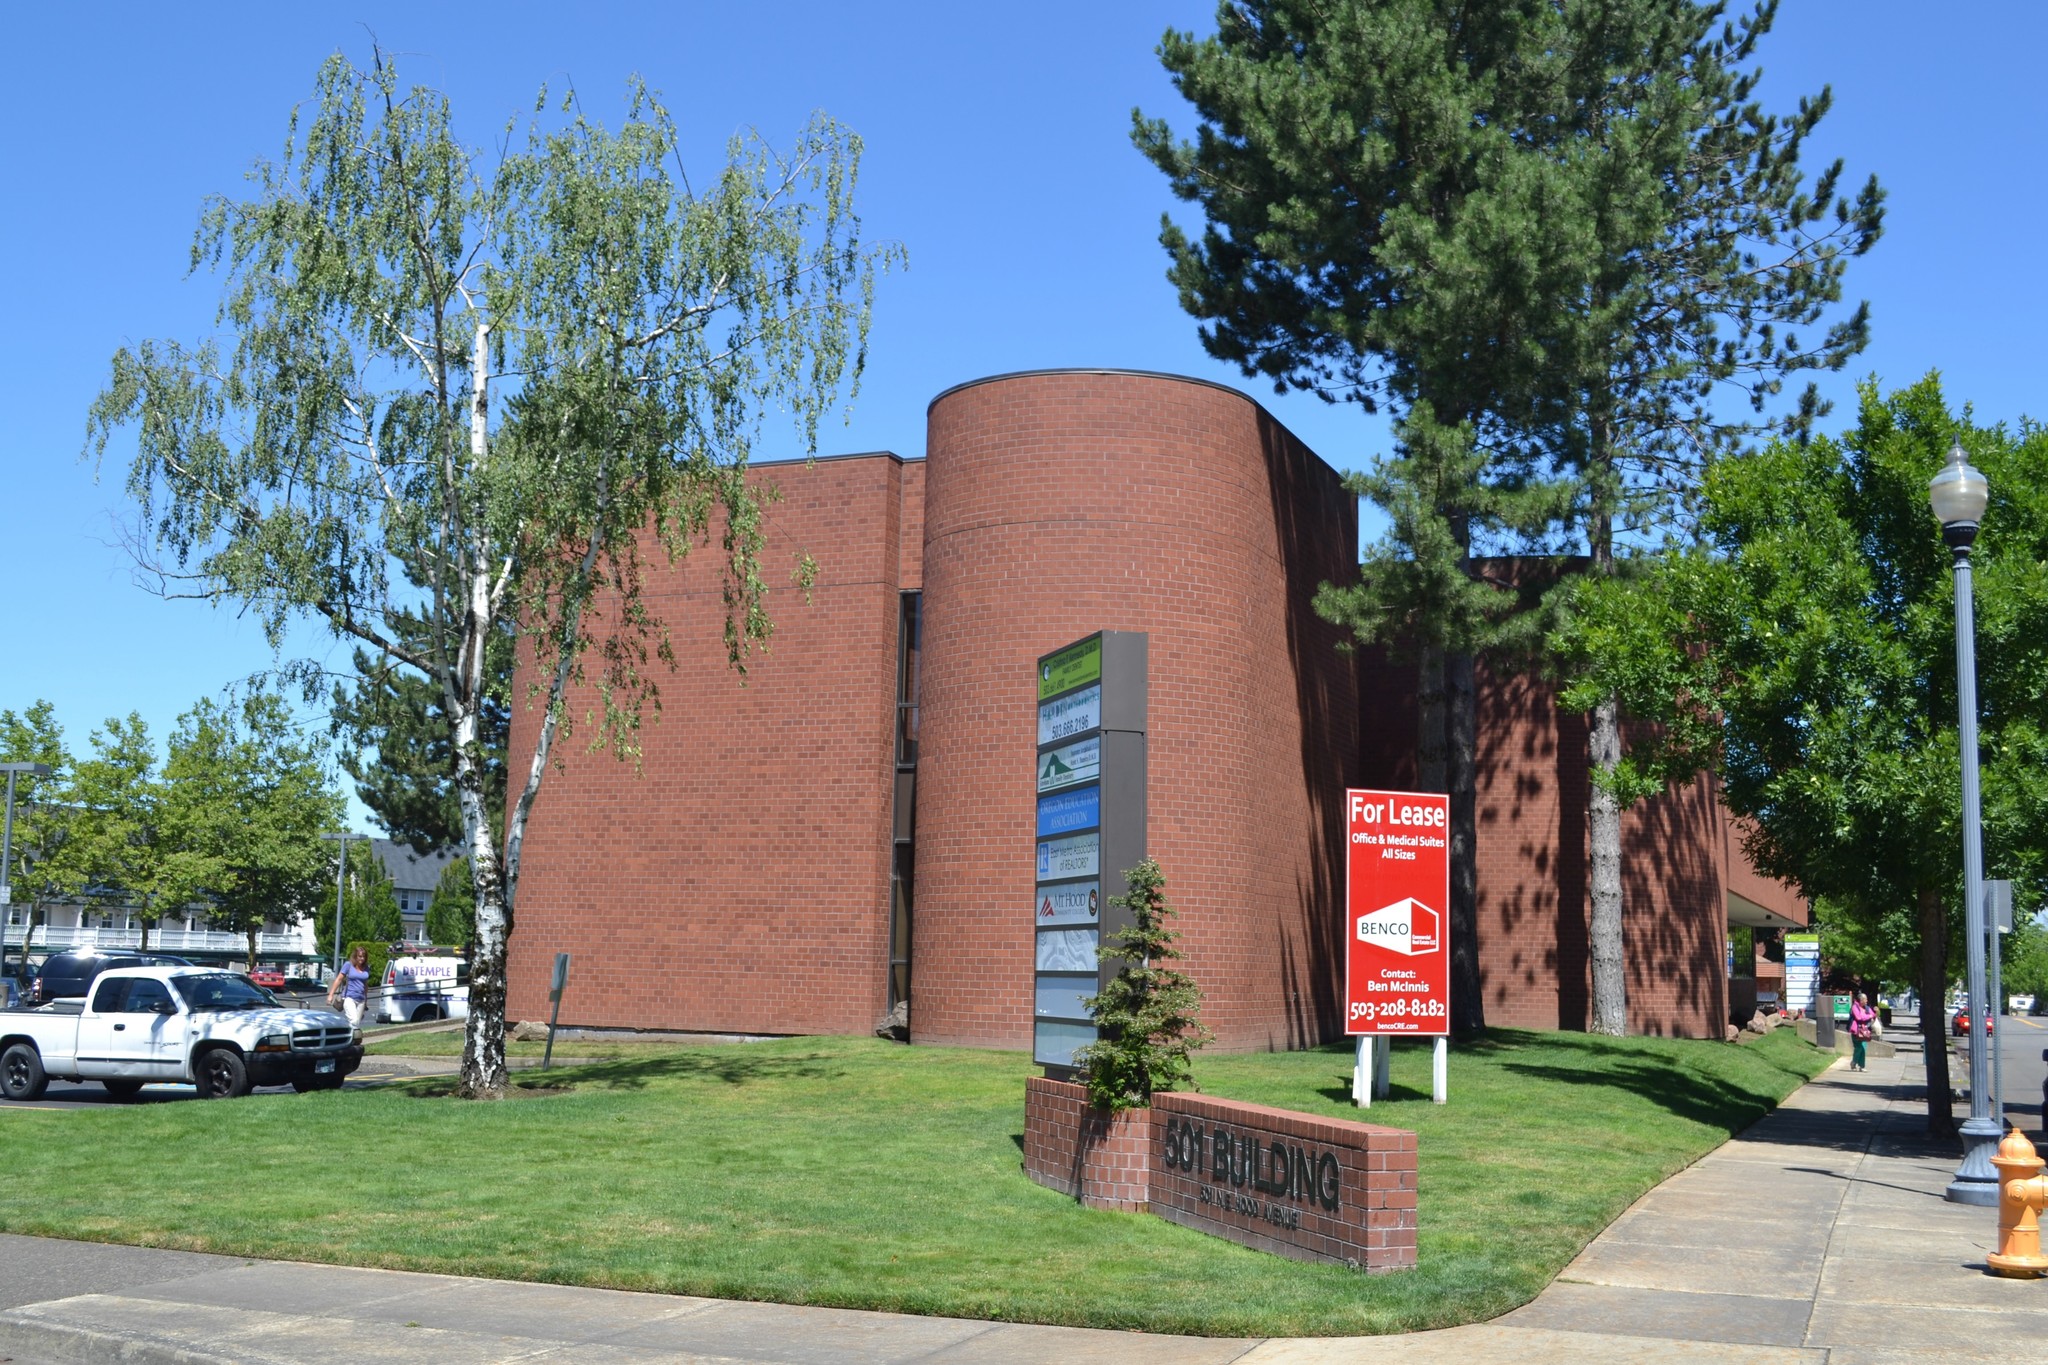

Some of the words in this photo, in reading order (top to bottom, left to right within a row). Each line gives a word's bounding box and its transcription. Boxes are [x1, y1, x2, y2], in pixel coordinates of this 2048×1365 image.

[1052, 715, 1089, 739] 503.666.2196
[1041, 800, 1064, 815] OREGON
[1065, 792, 1099, 810] EDUCATION
[1351, 796, 1385, 824] For
[1389, 798, 1445, 828] Lease
[1052, 812, 1087, 829] ASSOCIATION
[1352, 832, 1377, 845] Office
[1378, 834, 1386, 845] &
[1387, 834, 1418, 846] Medical
[1420, 836, 1445, 848] Suites
[1382, 848, 1393, 859] All
[1394, 848, 1416, 860] Sizes
[1361, 922, 1409, 935] BENCO
[1381, 968, 1416, 978] Contact:
[1367, 980, 1388, 992] Ben
[1390, 981, 1430, 992] McInnis
[1350, 998, 1445, 1021] 503-208-8182
[1377, 1022, 1419, 1030] bencoCRE.com
[1165, 1118, 1204, 1174] 501
[1213, 1129, 1339, 1212] BUILDING
[1264, 1202, 1299, 1230] AVENUE
